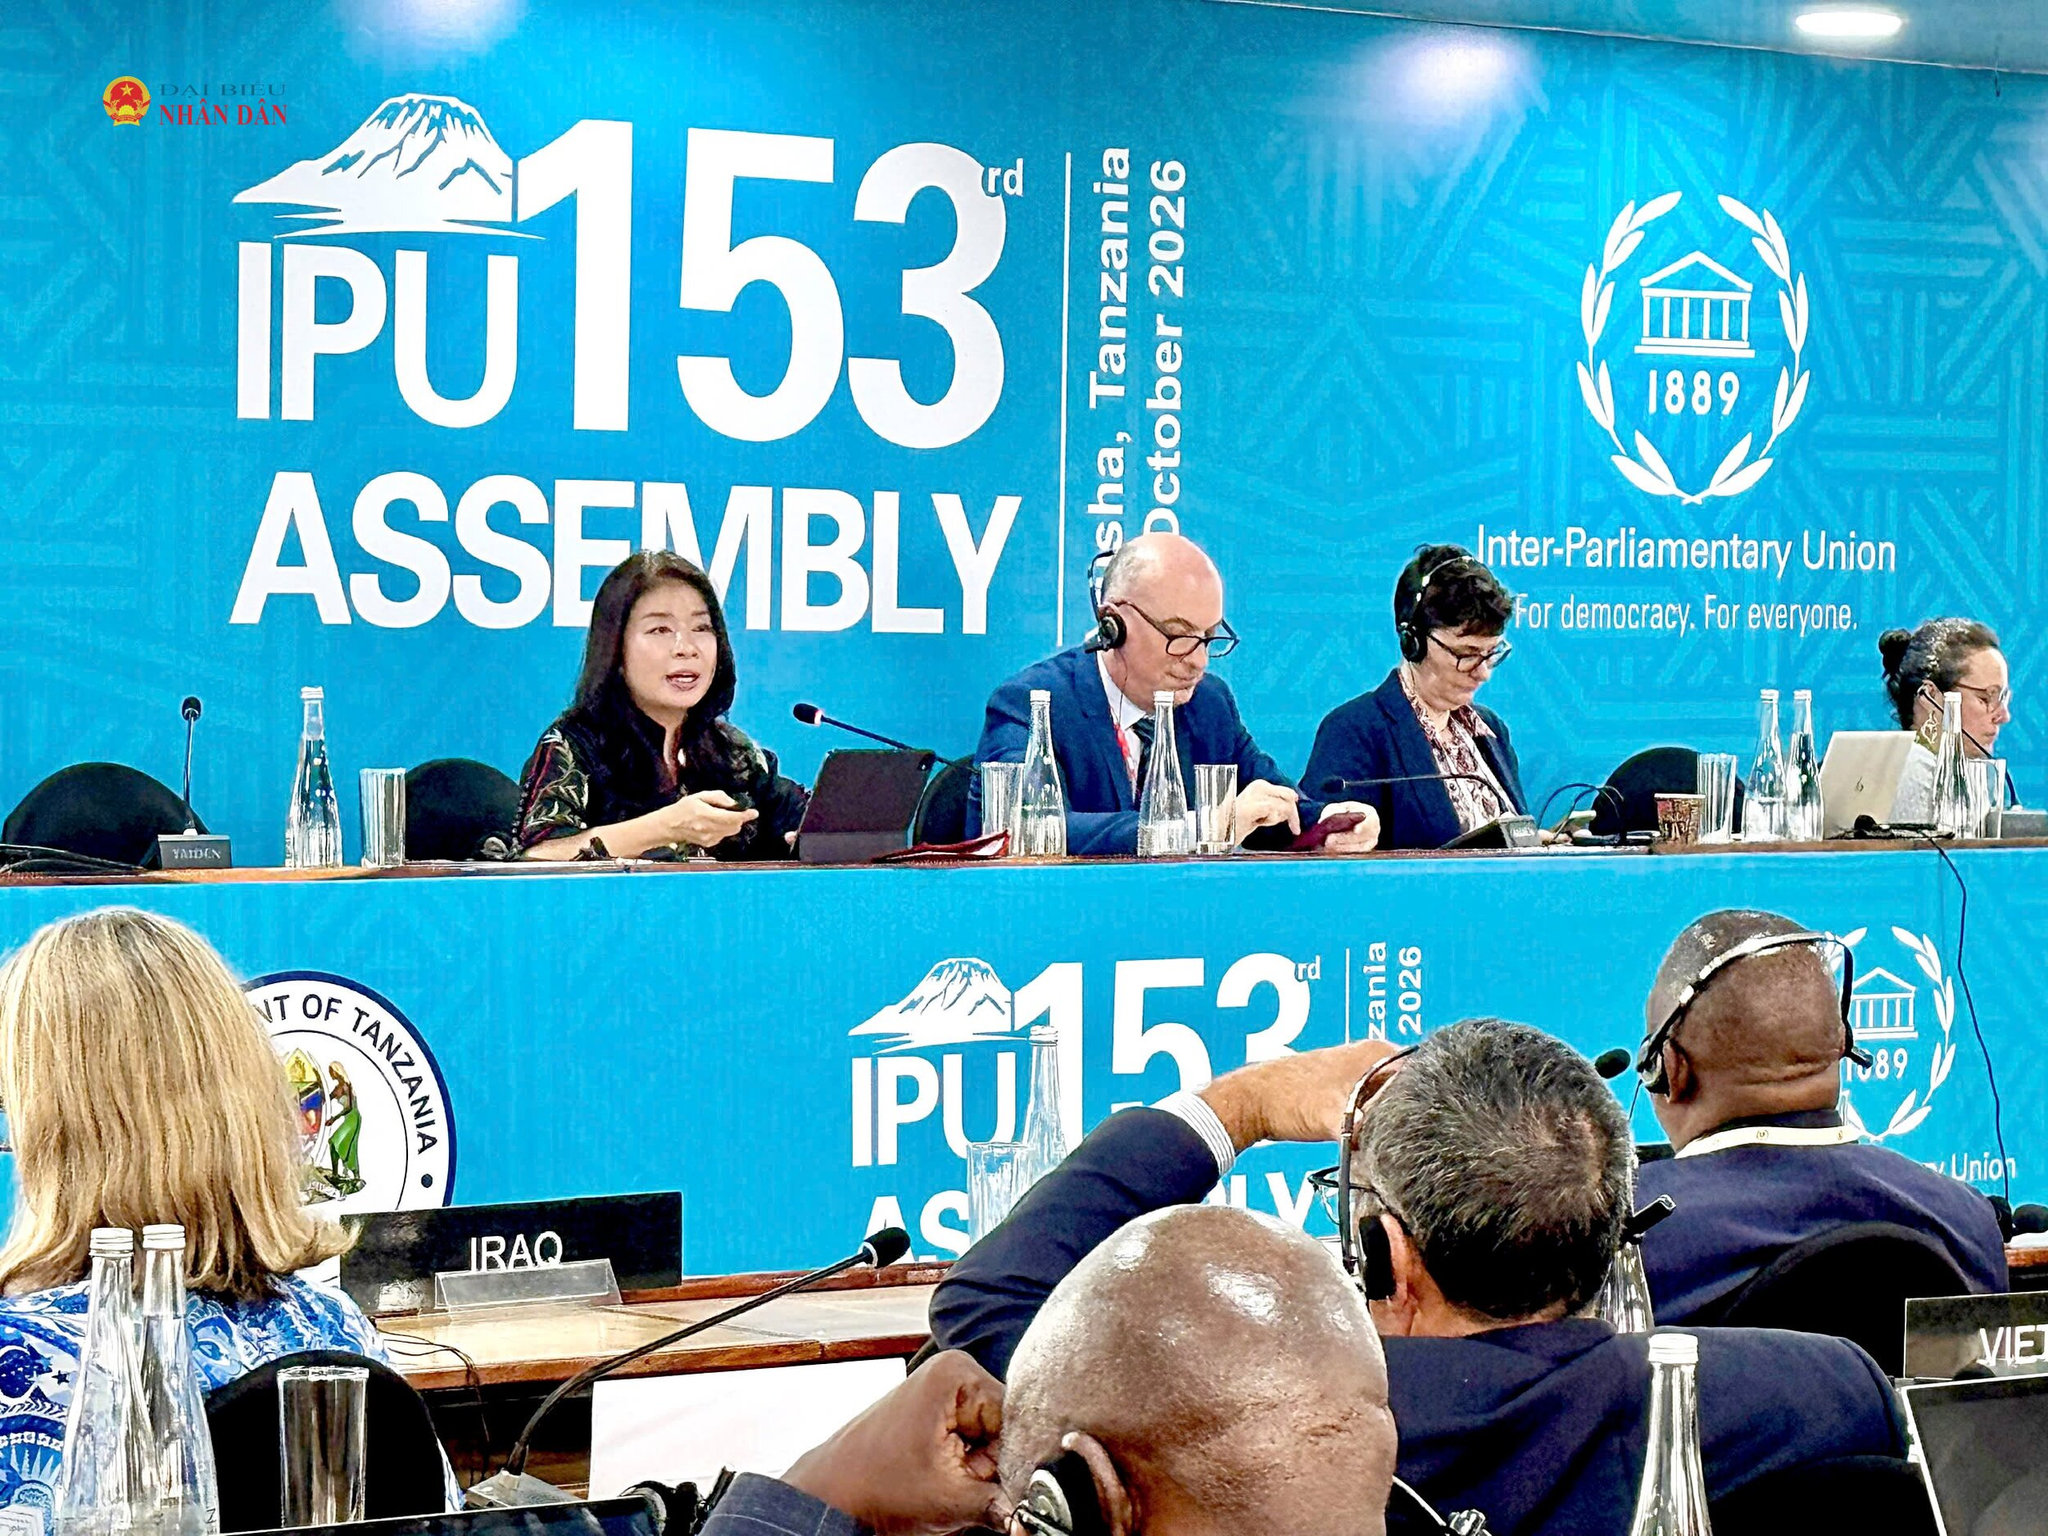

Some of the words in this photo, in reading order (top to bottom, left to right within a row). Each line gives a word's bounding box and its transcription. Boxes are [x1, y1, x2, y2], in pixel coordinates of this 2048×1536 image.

[1090, 147, 1130, 409] Tanzania
[1148, 160, 1186, 298] 2026
[236, 242, 518, 428] IPU
[1648, 369, 1740, 415] 1889
[1143, 313, 1182, 535] October
[229, 471, 1022, 635] ASSEMBLY
[1087, 432, 1133, 606] sha,
[1477, 524, 1793, 579] Inter-Parliamentary
[1803, 530, 1896, 571] Union
[1514, 594, 1553, 629] For
[1560, 594, 1696, 638] democracy.
[1704, 595, 1738, 629] For
[1747, 606, 1858, 638] everyone.
[1363, 942, 1386, 1040] zania
[1398, 946, 1422, 1036] 2026
[302, 993, 342, 1022] OF
[351, 1006, 438, 1156] TANZANIA
[851, 1053, 1016, 1167] IPU
[1951, 1152, 2016, 1181] Union
[470, 1230, 564, 1273] IRAQ
